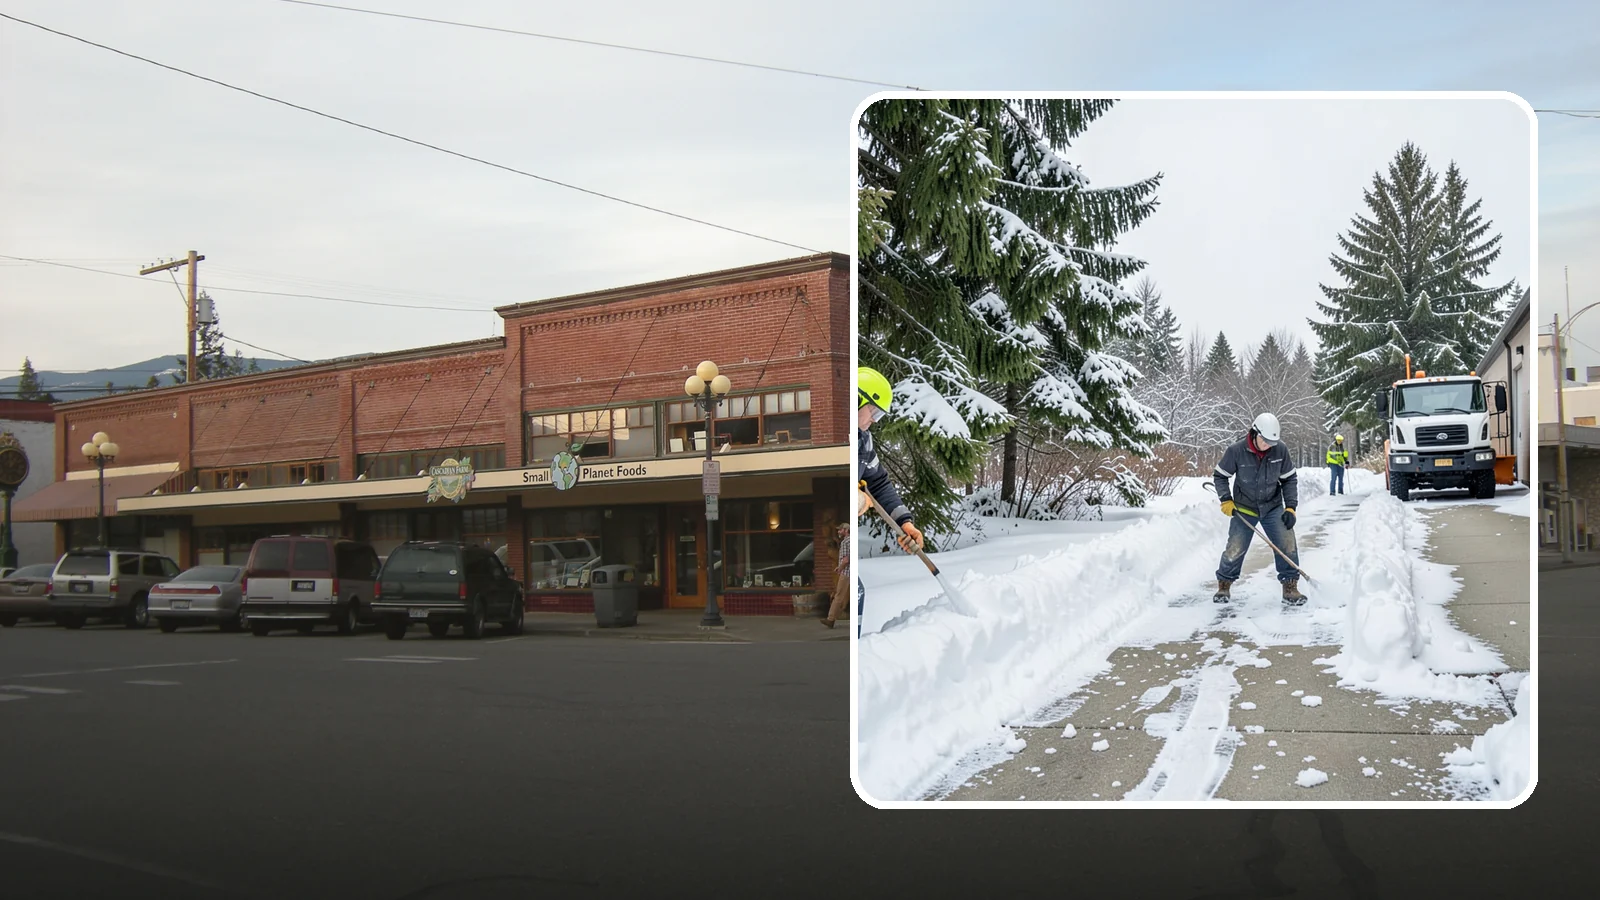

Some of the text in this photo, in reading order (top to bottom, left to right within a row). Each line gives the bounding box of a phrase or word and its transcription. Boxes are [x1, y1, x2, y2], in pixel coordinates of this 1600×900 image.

[523, 464, 647, 483] Small Planet Foods
